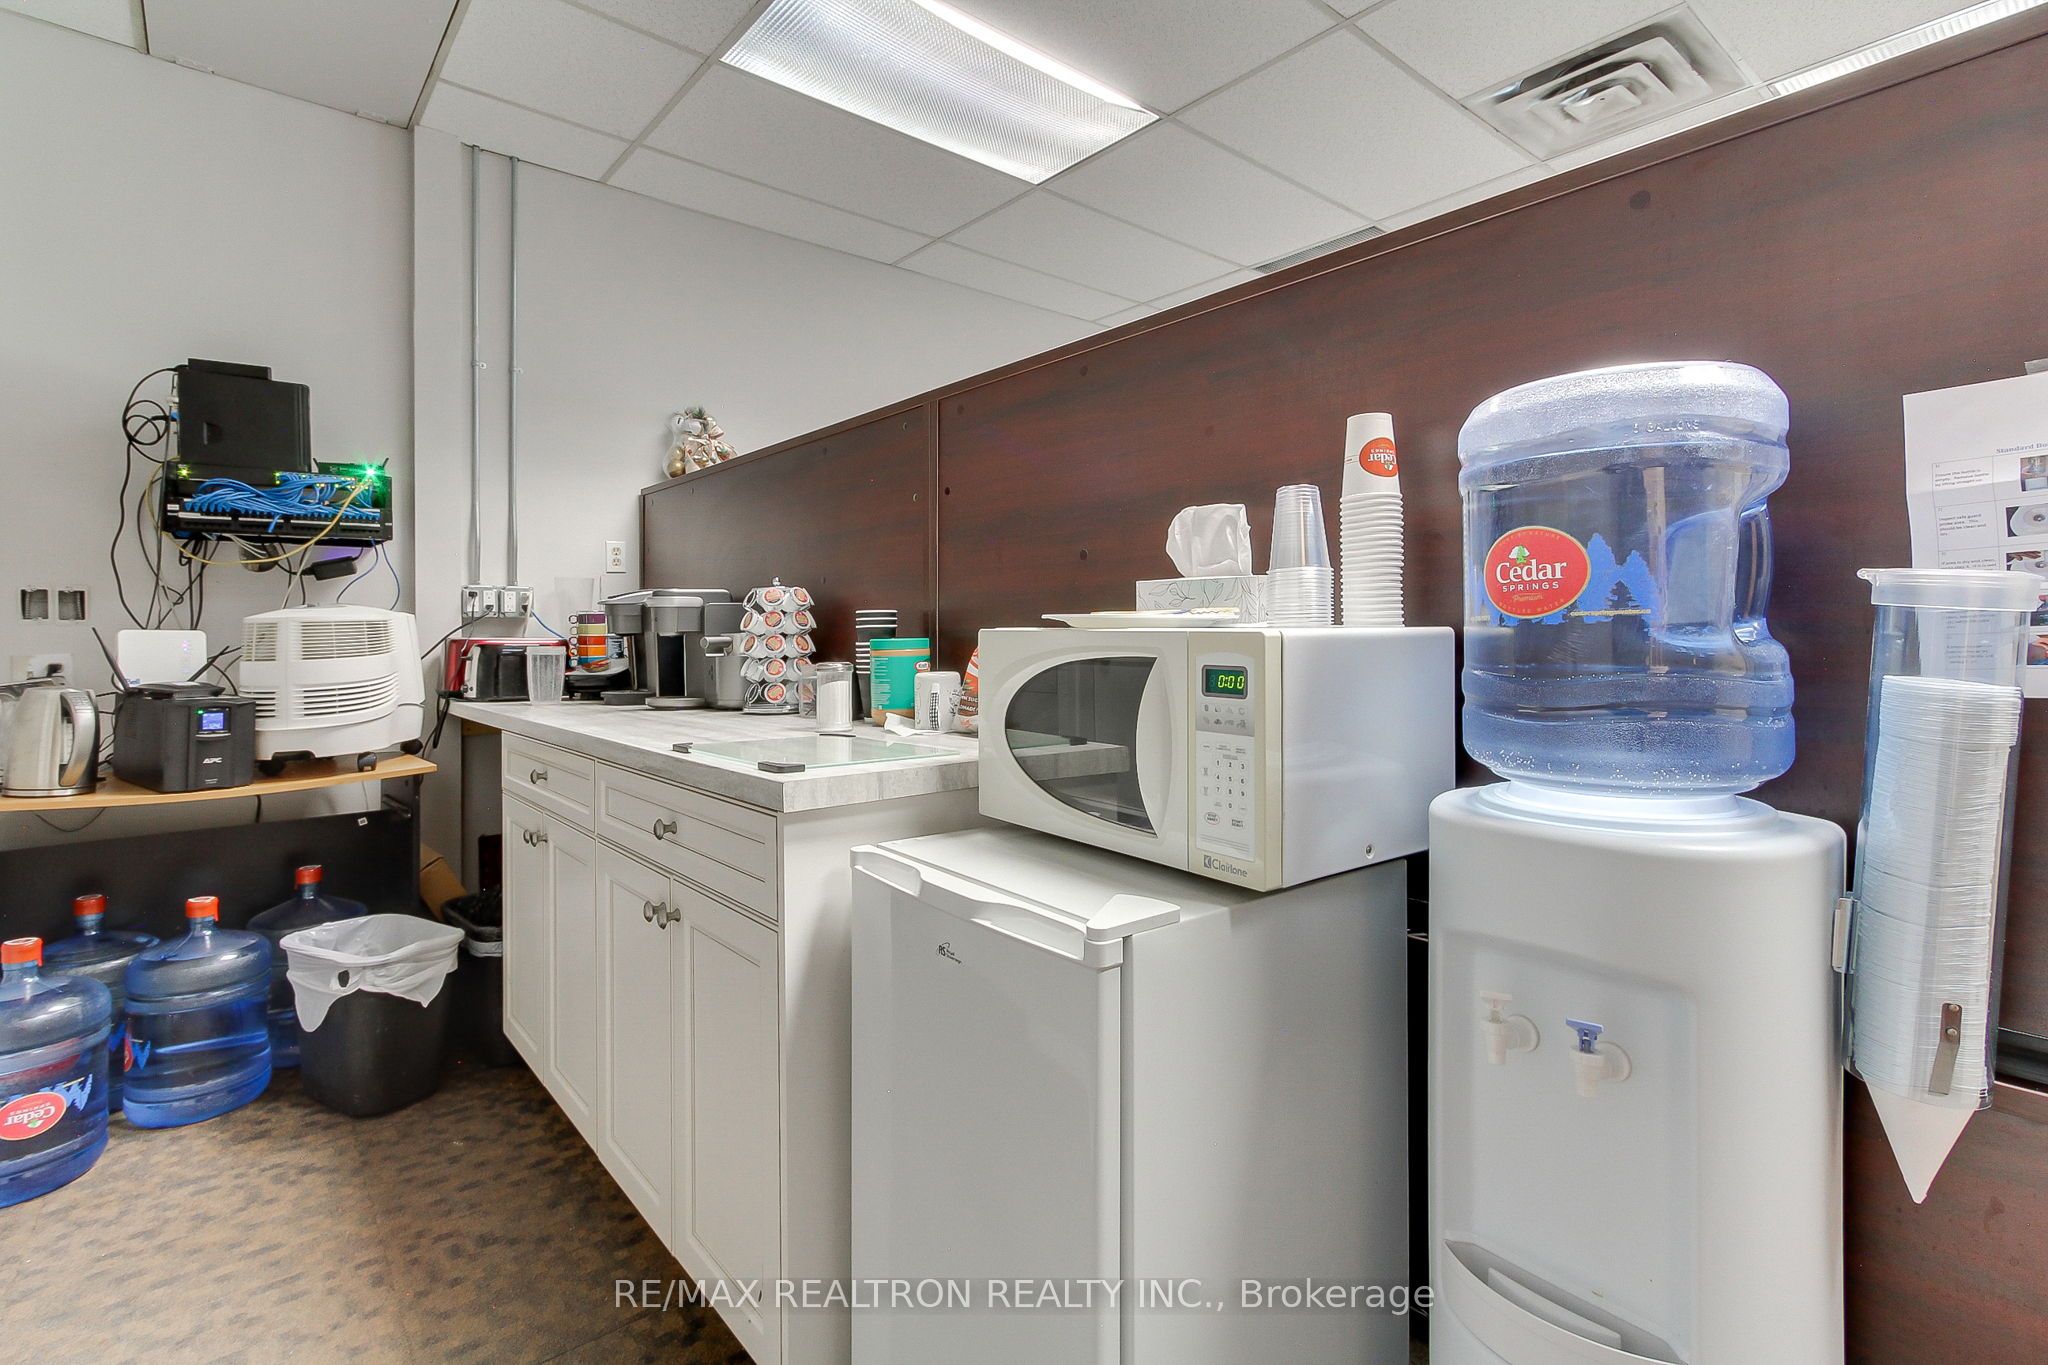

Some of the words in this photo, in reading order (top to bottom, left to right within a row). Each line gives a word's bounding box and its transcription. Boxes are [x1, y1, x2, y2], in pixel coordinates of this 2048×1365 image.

[1496, 558, 1567, 584] Cedar
[1503, 581, 1559, 593] SPRINGS
[1217, 674, 1245, 689] 0:00
[4, 1105, 56, 1126] Cedar
